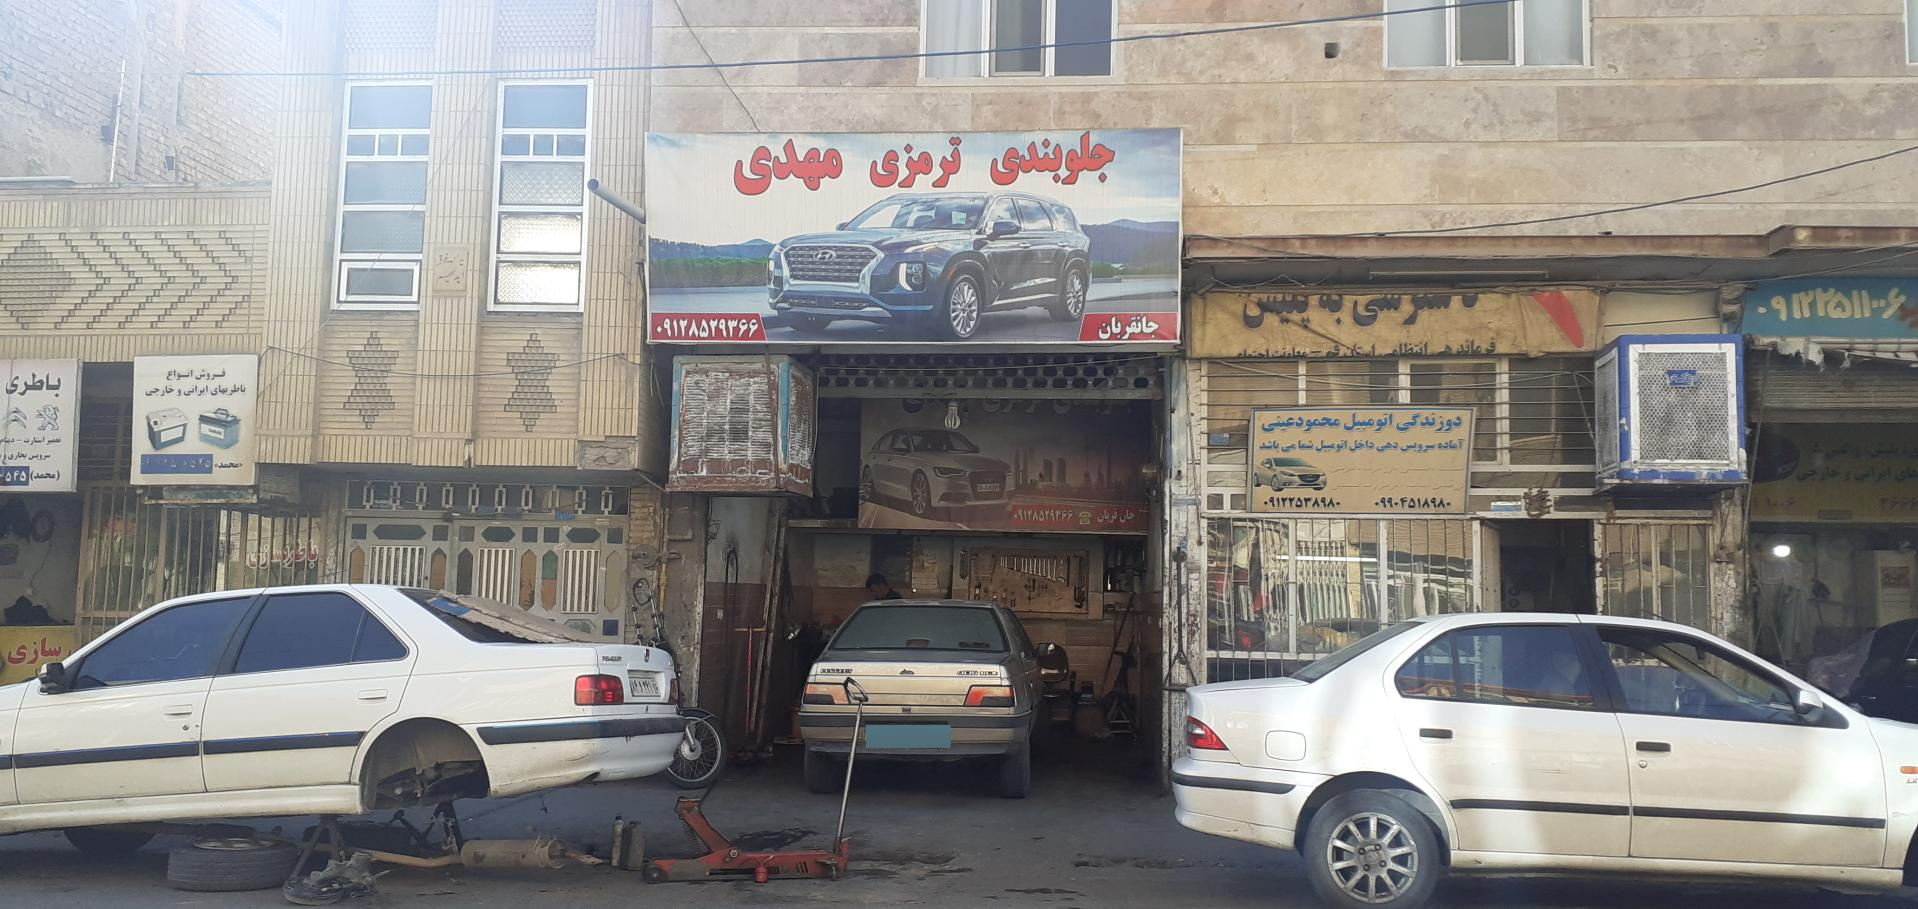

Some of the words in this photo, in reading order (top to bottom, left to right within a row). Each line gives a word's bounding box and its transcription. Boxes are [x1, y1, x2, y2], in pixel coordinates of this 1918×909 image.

[870, 136, 962, 189] ترمزی
[991, 130, 1116, 187] جلوبندی
[733, 138, 844, 197] مهدی
[656, 318, 758, 338] ۰۹۱۲۸۵۲۹۳۶۶
[166, 369, 194, 381] انواع
[195, 367, 226, 380] فروش
[5, 371, 62, 398] باطری
[145, 385, 174, 397] خارجی
[177, 389, 183, 397] و
[184, 385, 209, 397] ایرانی
[1343, 412, 1393, 432] اتومبیل
[1395, 413, 1462, 432] دوزندگی
[1259, 440, 1280, 452] باشد
[1297, 440, 1313, 450] شما
[1315, 440, 1348, 452] اتومبیل
[1348, 441, 1374, 452] داخل
[1376, 441, 1398, 452] دهی
[1400, 441, 1436, 452] سرویس
[1437, 439, 1464, 449] آماده
[7, 451, 27, 460] بخاری
[1263, 496, 1341, 509] ۰۹۱۲۲۵۳۸۹۸۰
[1374, 496, 1451, 509] ۰۹۹۰۴۵۱۸۹۸۰
[7, 636, 62, 665] سازی
